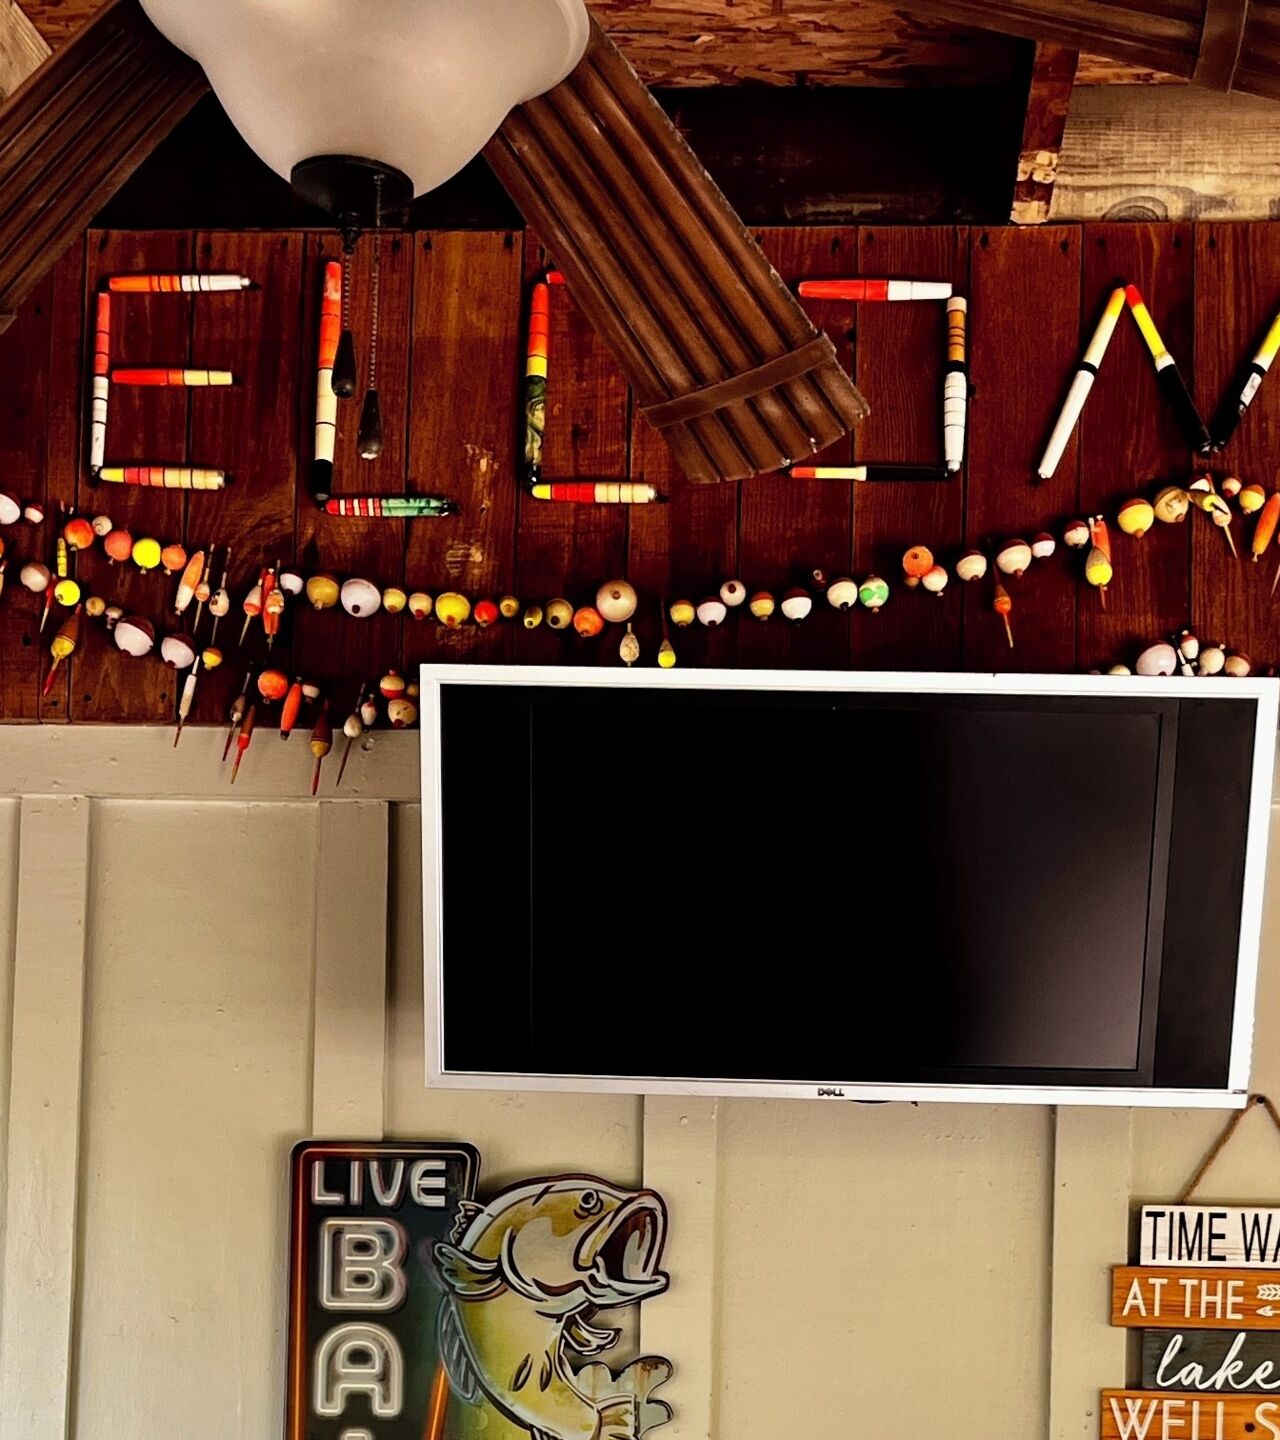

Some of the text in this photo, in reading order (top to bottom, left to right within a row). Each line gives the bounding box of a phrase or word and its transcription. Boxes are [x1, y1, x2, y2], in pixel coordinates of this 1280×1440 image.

[817, 1087, 845, 1097] DELL
[311, 1158, 448, 1208] LIVE
[1144, 1210, 1228, 1263] TIME
[1121, 1276, 1245, 1321] AT THE
